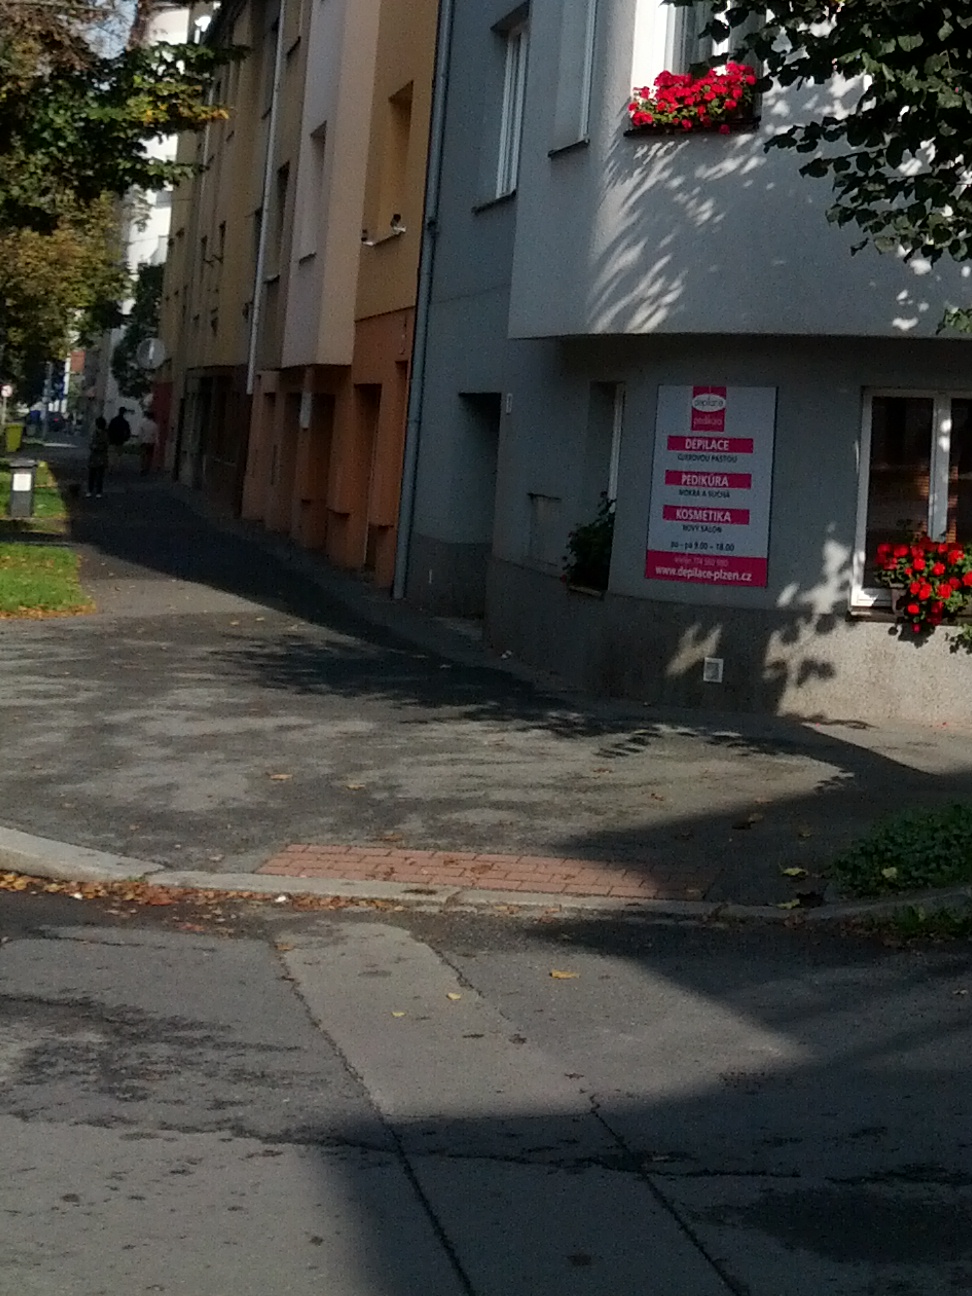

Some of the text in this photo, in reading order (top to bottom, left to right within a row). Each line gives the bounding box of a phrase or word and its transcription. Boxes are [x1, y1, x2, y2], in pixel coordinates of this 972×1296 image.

[685, 438, 730, 450] DEPILACE
[681, 472, 729, 487] PEDIKÚRA
[675, 508, 732, 523] KOSMETIKA
[655, 565, 752, 582] www.depilace-plzen.cz
